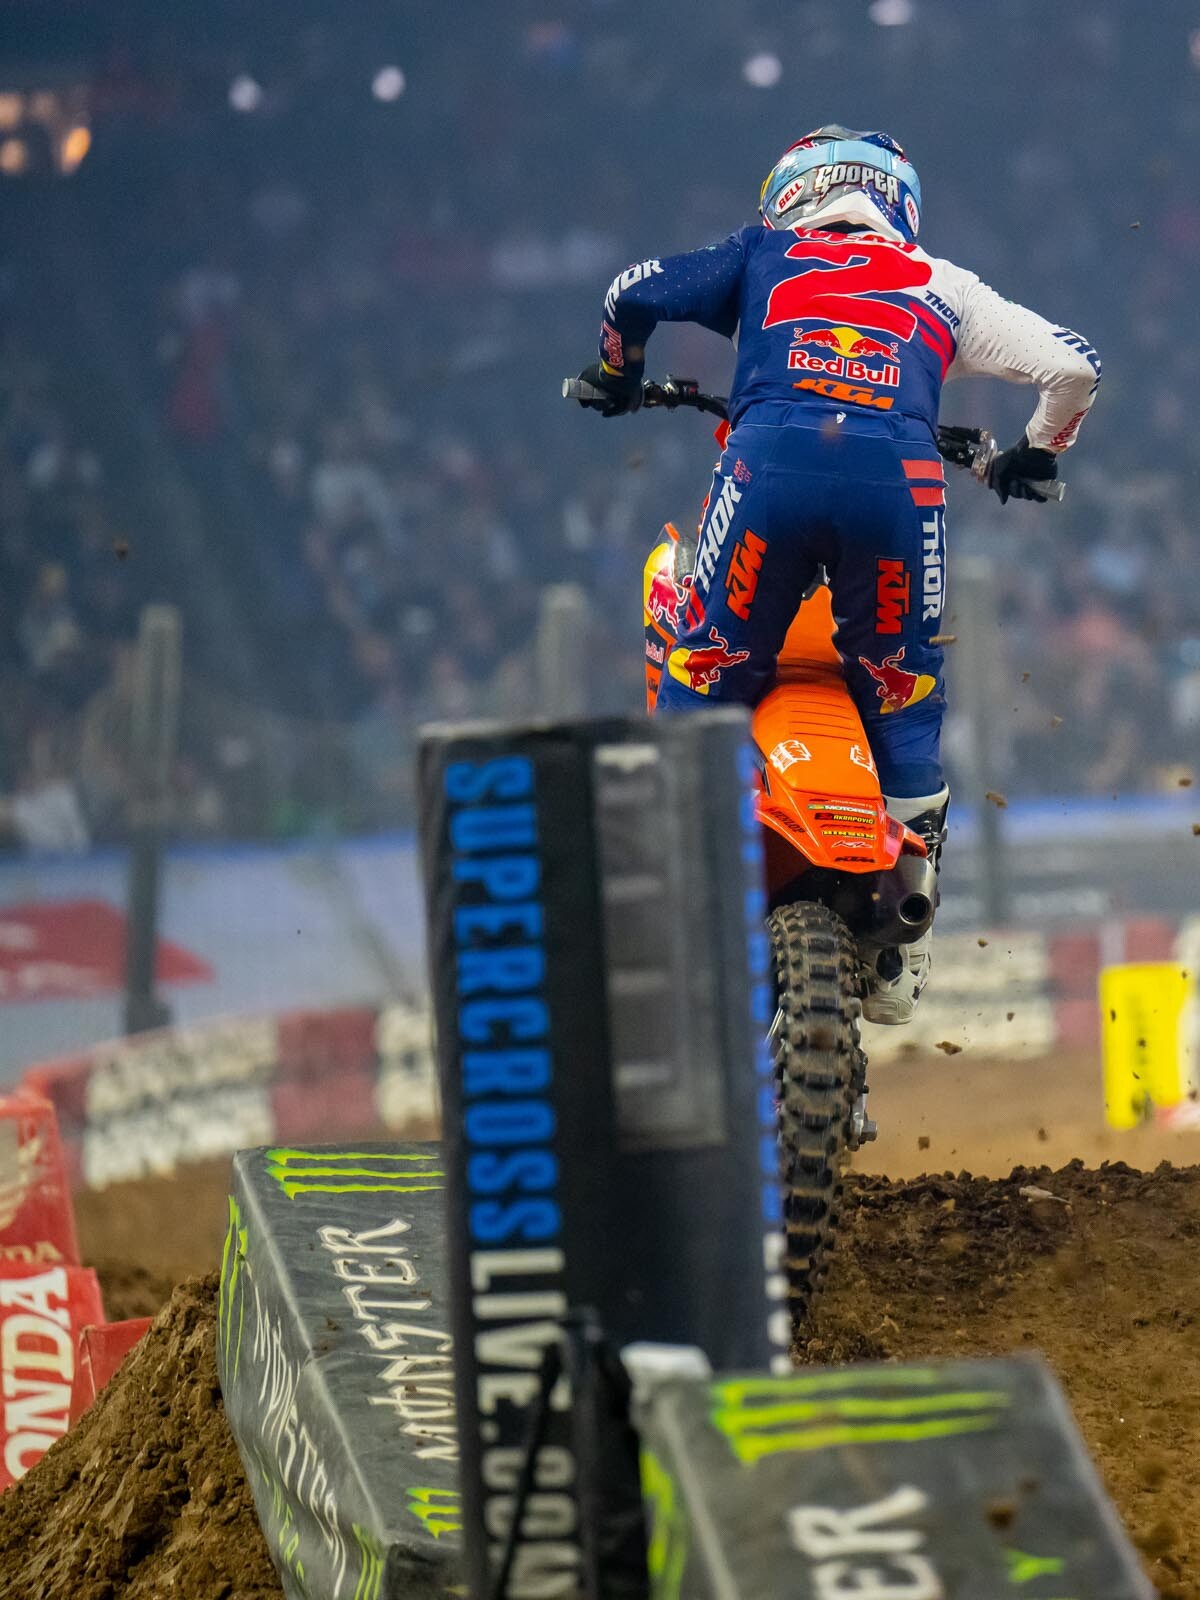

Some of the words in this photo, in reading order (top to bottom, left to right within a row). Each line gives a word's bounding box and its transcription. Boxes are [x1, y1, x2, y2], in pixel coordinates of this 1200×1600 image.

[778, 182, 804, 209] BELL
[763, 241, 933, 342] 2
[924, 289, 961, 330] THOR
[787, 349, 844, 378] Red
[846, 361, 900, 388] Bull
[792, 377, 895, 410] KTM
[696, 476, 743, 593] THOR
[725, 528, 768, 622] KTM
[922, 510, 942, 622] THOR
[876, 558, 911, 634] KTM
[3, 1268, 75, 1482] ONDA
